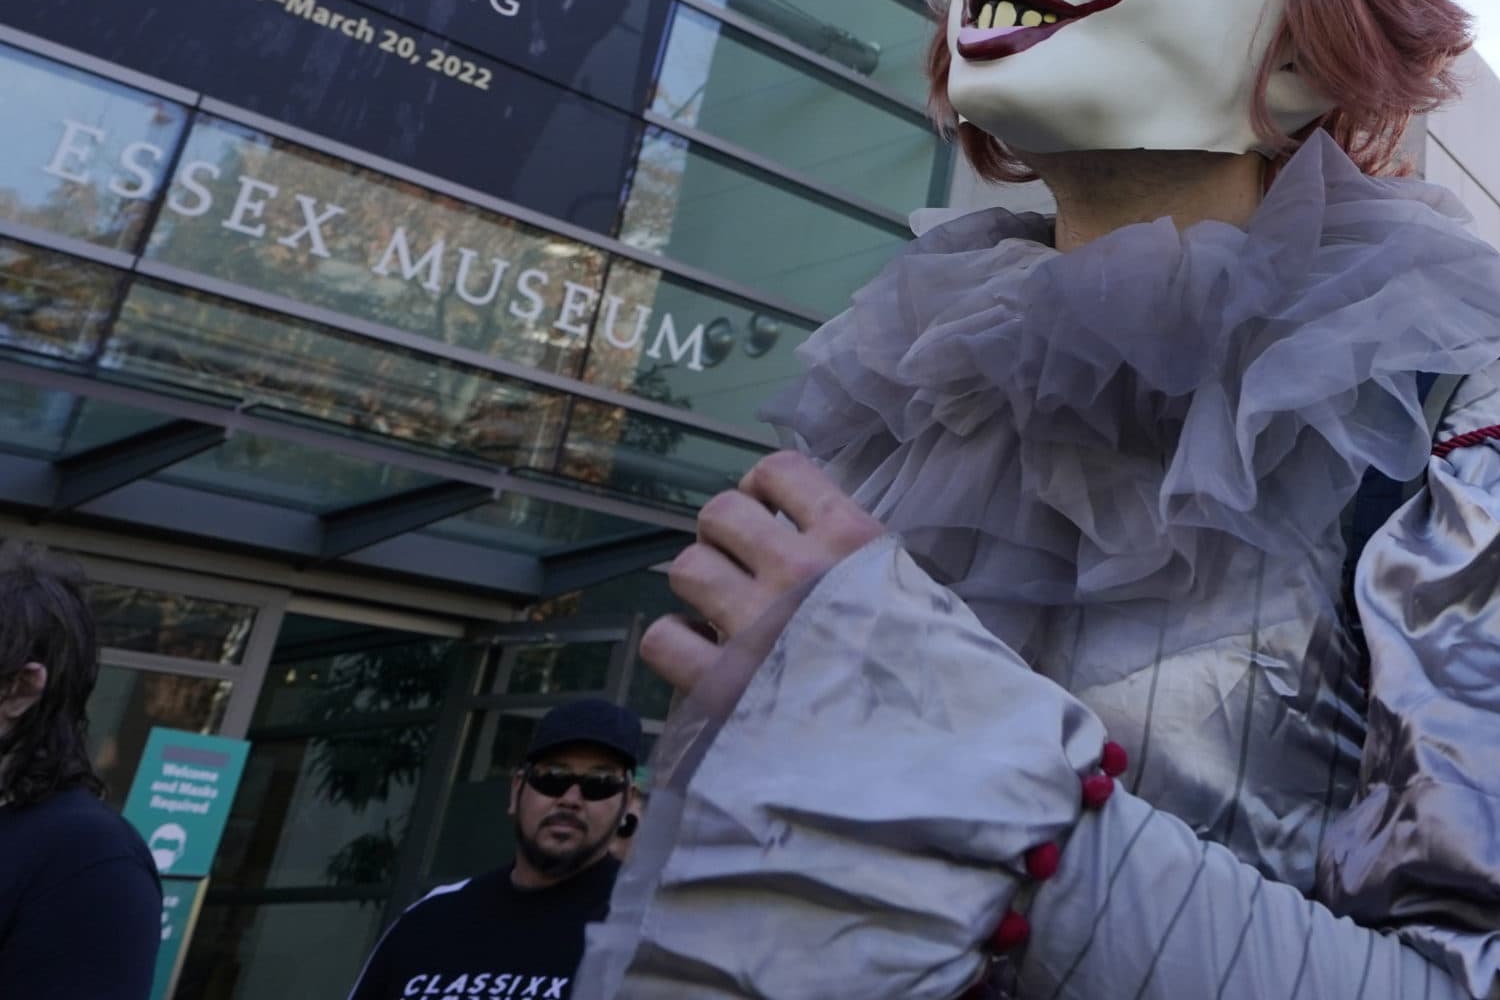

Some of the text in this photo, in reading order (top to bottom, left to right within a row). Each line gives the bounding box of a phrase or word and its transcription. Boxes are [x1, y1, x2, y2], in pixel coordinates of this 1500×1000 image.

[378, 28, 422, 65] 20,
[425, 48, 494, 91] 2022
[43, 118, 706, 371] ESSEX MUSEUM
[403, 972, 569, 999] CLASSIXX
